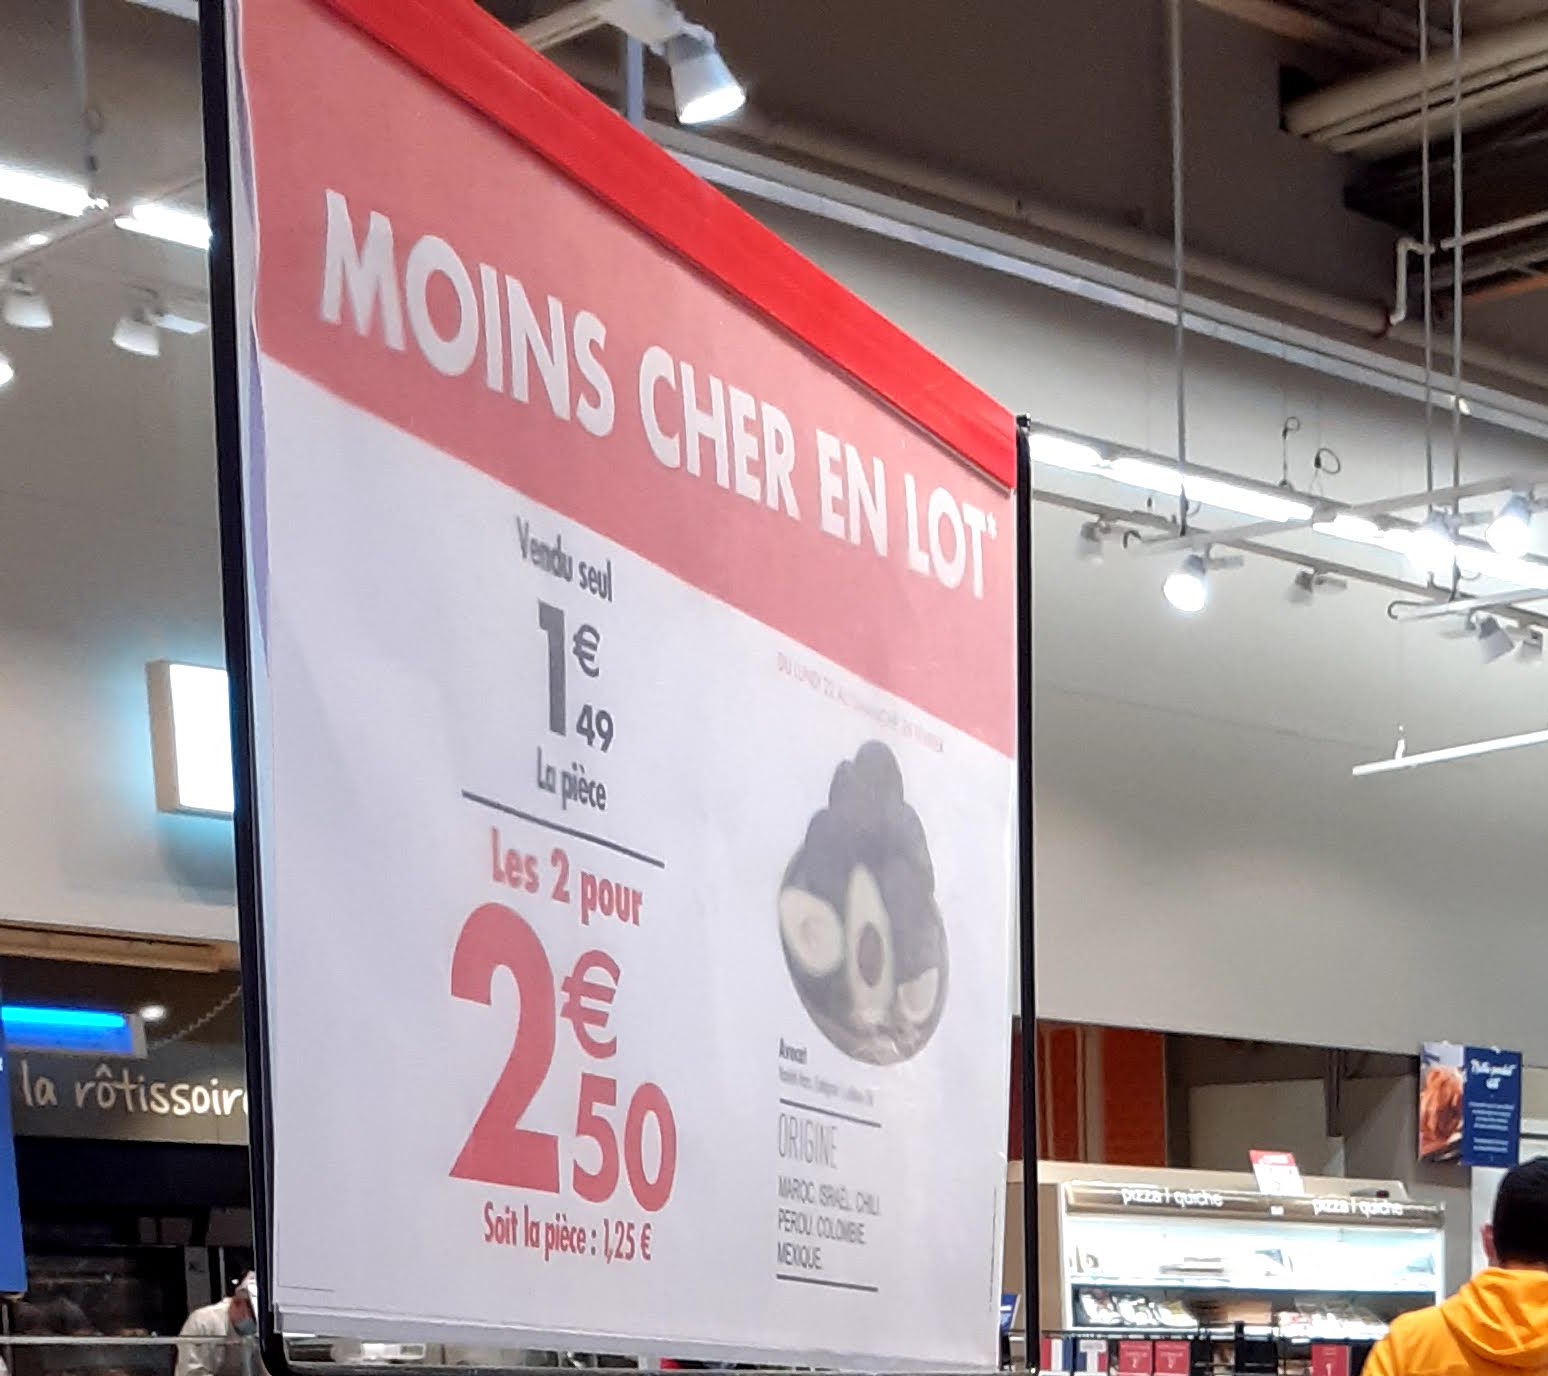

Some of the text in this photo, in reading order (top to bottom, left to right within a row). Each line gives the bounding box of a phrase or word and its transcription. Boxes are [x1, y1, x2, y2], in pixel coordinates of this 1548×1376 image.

[319, 188, 617, 438] MOINS
[638, 344, 801, 523] CHER
[815, 428, 890, 559] EN
[516, 515, 613, 602] Vendu seul
[536, 746, 607, 811] La pièce
[490, 827, 643, 926] Les 2 pour
[20, 1059, 57, 1108] la
[777, 1112, 838, 1169] ORIGINE
[483, 1201, 518, 1247] Soit
[523, 1204, 541, 1249] la
[544, 1212, 587, 1261] pièce
[603, 1218, 636, 1265] 1,25
[640, 1222, 653, 1262] €
